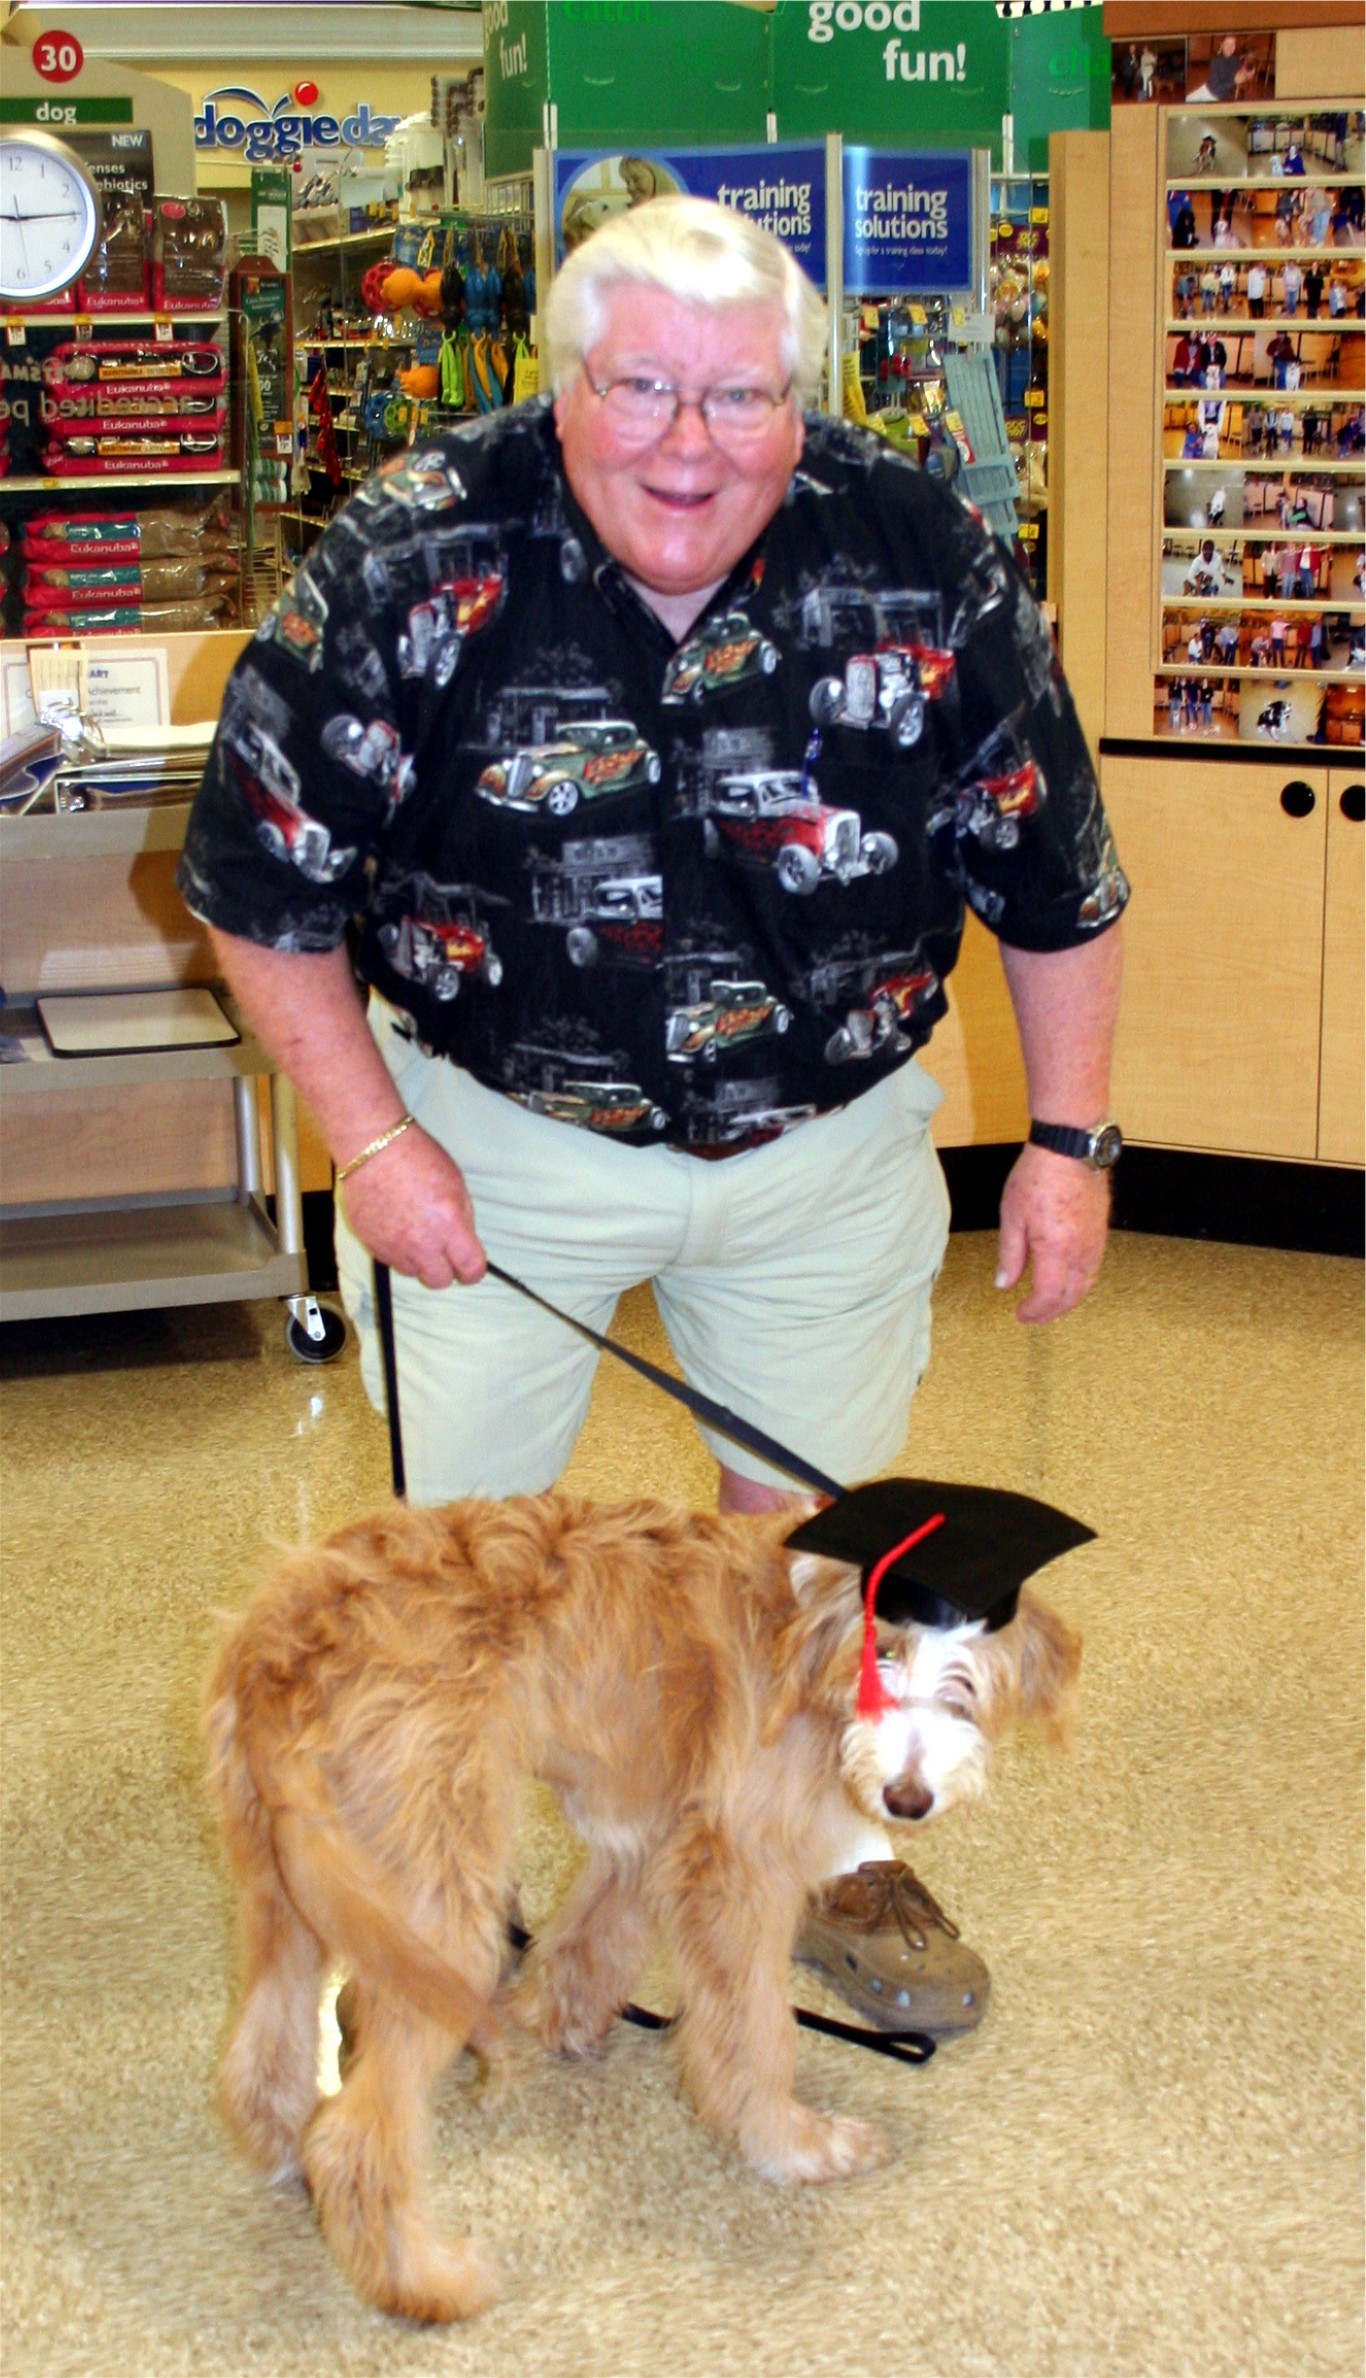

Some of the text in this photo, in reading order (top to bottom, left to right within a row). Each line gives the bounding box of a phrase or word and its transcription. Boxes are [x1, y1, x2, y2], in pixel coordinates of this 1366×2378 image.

[808, 1, 920, 43] good
[41, 45, 77, 72] 30
[500, 32, 528, 80] fun!
[884, 38, 966, 82] fun!
[36, 102, 77, 125] dog
[194, 101, 340, 163] doggie
[112, 134, 144, 148] NEW
[9, 157, 22, 171] 12
[40, 164, 45, 179] 1
[62, 184, 70, 198] 2
[717, 178, 811, 215] training
[855, 182, 948, 220] training
[855, 214, 948, 240] solutions
[62, 242, 70, 253] 4
[45, 259, 52, 273] 5
[17, 267, 26, 280] 6
[103, 419, 161, 430] Eukanuba
[104, 460, 163, 470] Eukanuba
[70, 542, 132, 554] Eukanuba
[72, 588, 134, 600] Eukanuba
